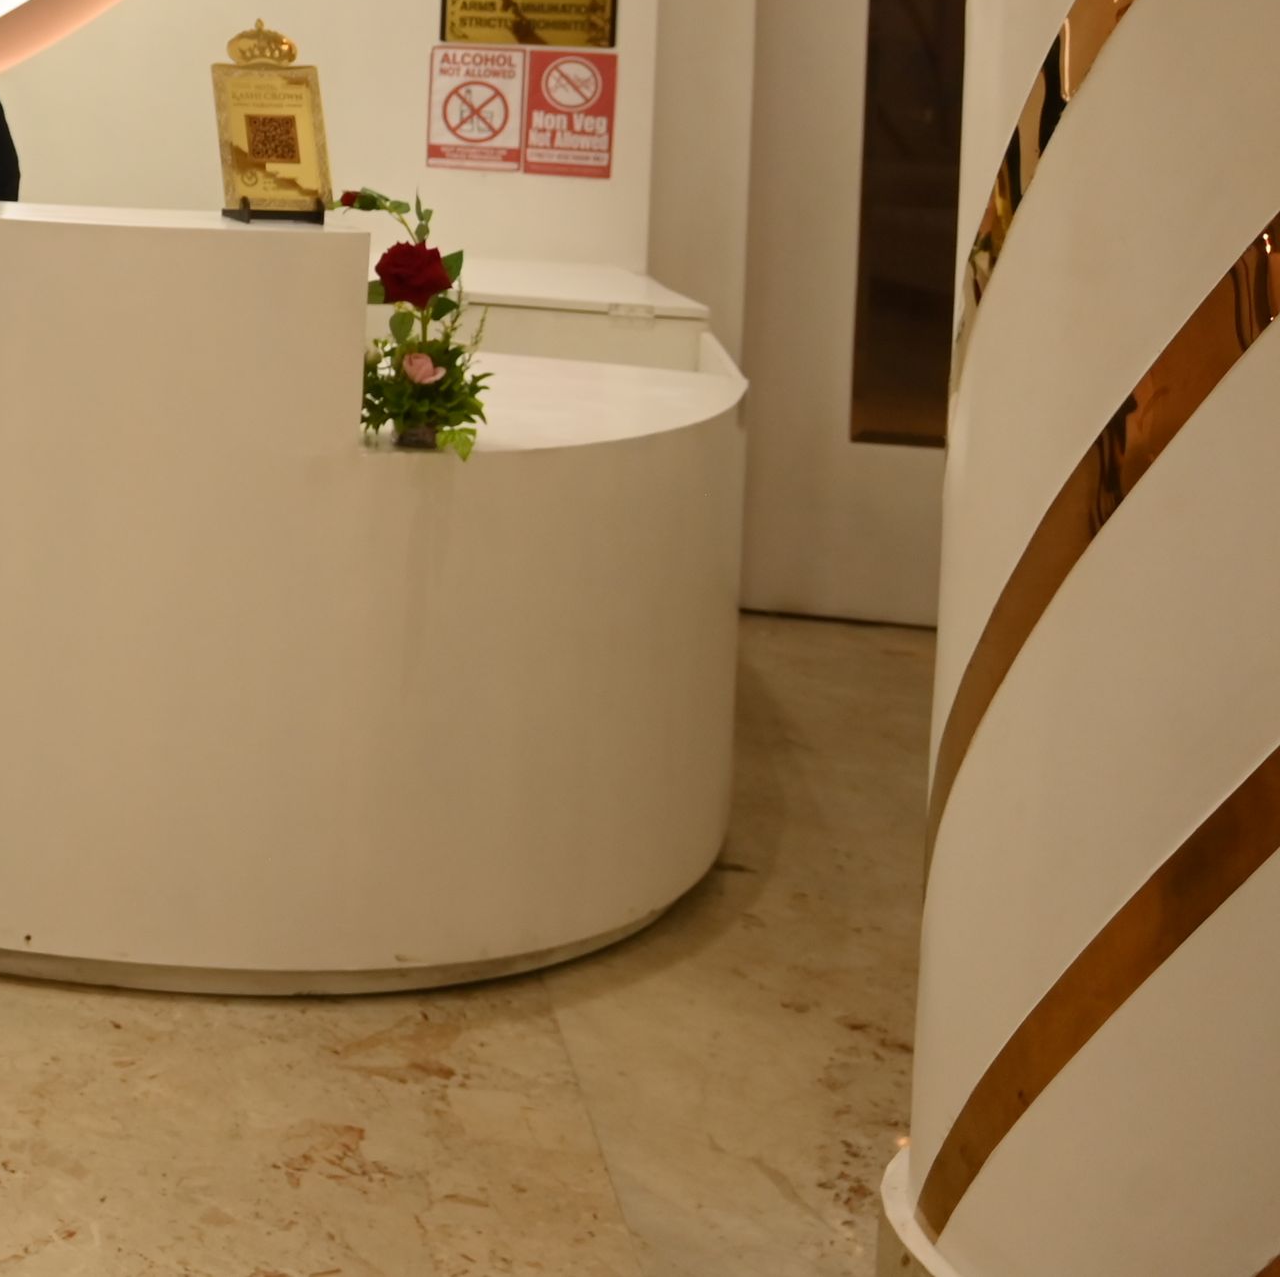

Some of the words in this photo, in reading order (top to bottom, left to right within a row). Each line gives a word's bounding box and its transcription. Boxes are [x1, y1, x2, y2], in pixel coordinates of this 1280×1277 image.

[459, 0, 497, 12] ARMS
[441, 52, 517, 67] ALCOHOL
[439, 67, 461, 77] NOT
[464, 69, 516, 79] ALLOWED
[532, 110, 568, 130] Non
[573, 112, 608, 136] Veg
